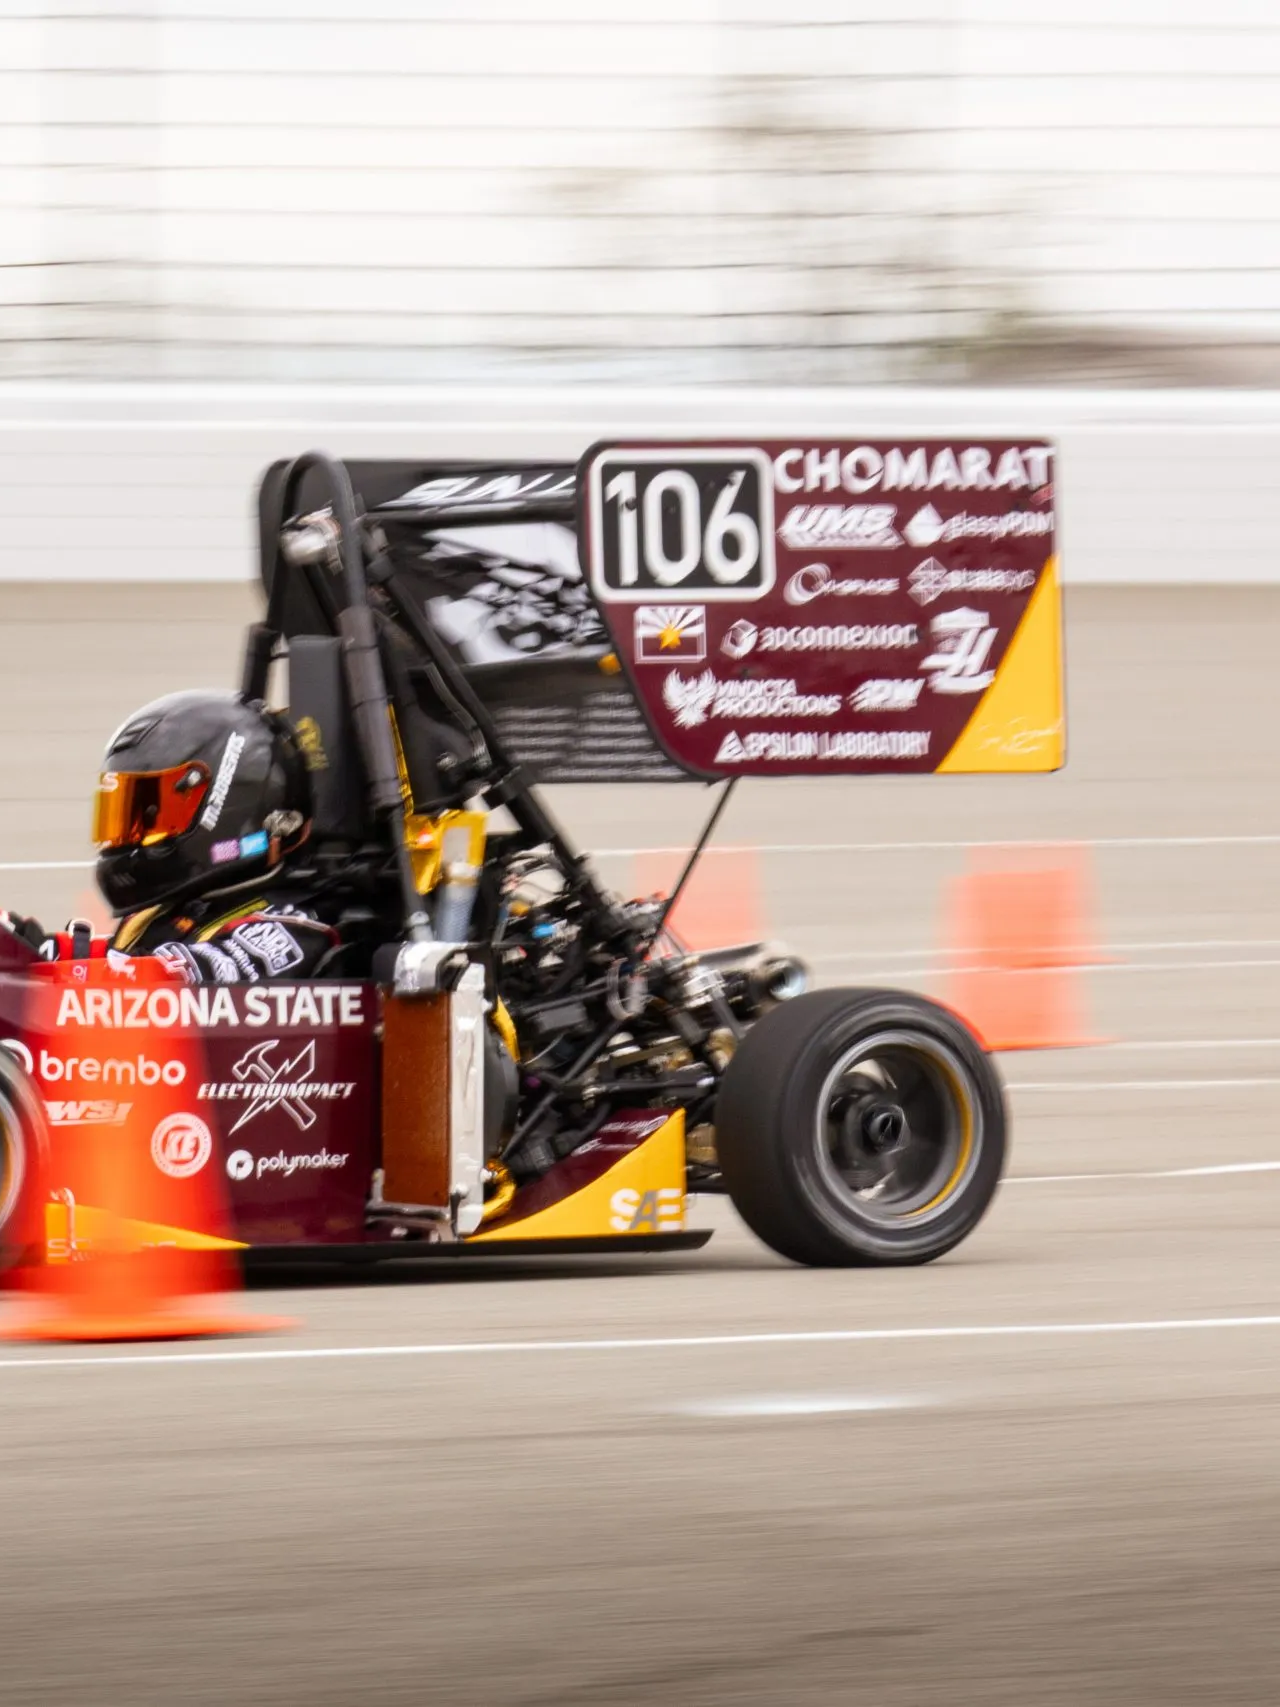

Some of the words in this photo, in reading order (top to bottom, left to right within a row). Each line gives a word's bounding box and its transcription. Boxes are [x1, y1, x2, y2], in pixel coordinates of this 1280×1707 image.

[773, 446, 1056, 494] CHOMARAT
[605, 468, 760, 587] 106
[710, 695, 842, 718] PRODUCTIONS
[56, 988, 240, 1028] ARIZONA
[244, 986, 364, 1026] STATE
[40, 1050, 186, 1086] brembo
[197, 1082, 357, 1100] ELECTROIMPACT
[256, 1147, 350, 1180] polymaker
[609, 1187, 683, 1232] SAE
